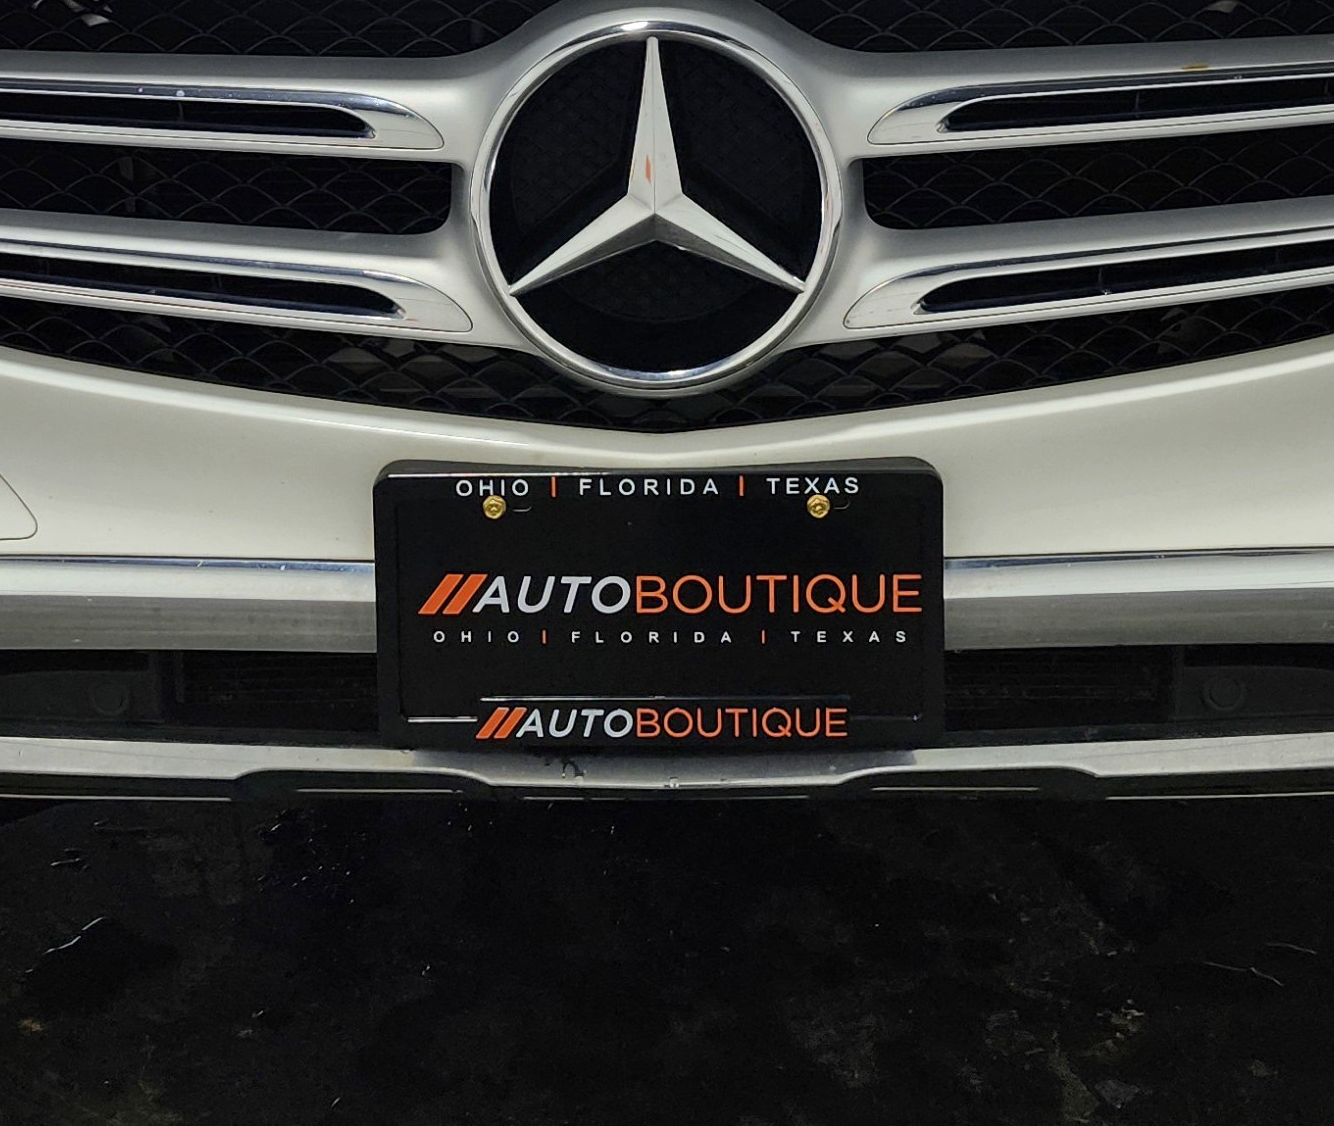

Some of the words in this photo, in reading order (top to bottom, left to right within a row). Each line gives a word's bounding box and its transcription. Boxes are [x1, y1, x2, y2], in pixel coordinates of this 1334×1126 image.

[455, 478, 529, 497] OHIO
[579, 478, 719, 496] FLORIDA
[766, 476, 859, 495] TEXAS
[472, 573, 923, 615] AUTOBOUTIQUE
[433, 629, 520, 643] OHIO
[571, 630, 732, 644] FLORIDA
[790, 630, 906, 643] TEXAS
[515, 707, 849, 739] AUTOBOUTIQUE
